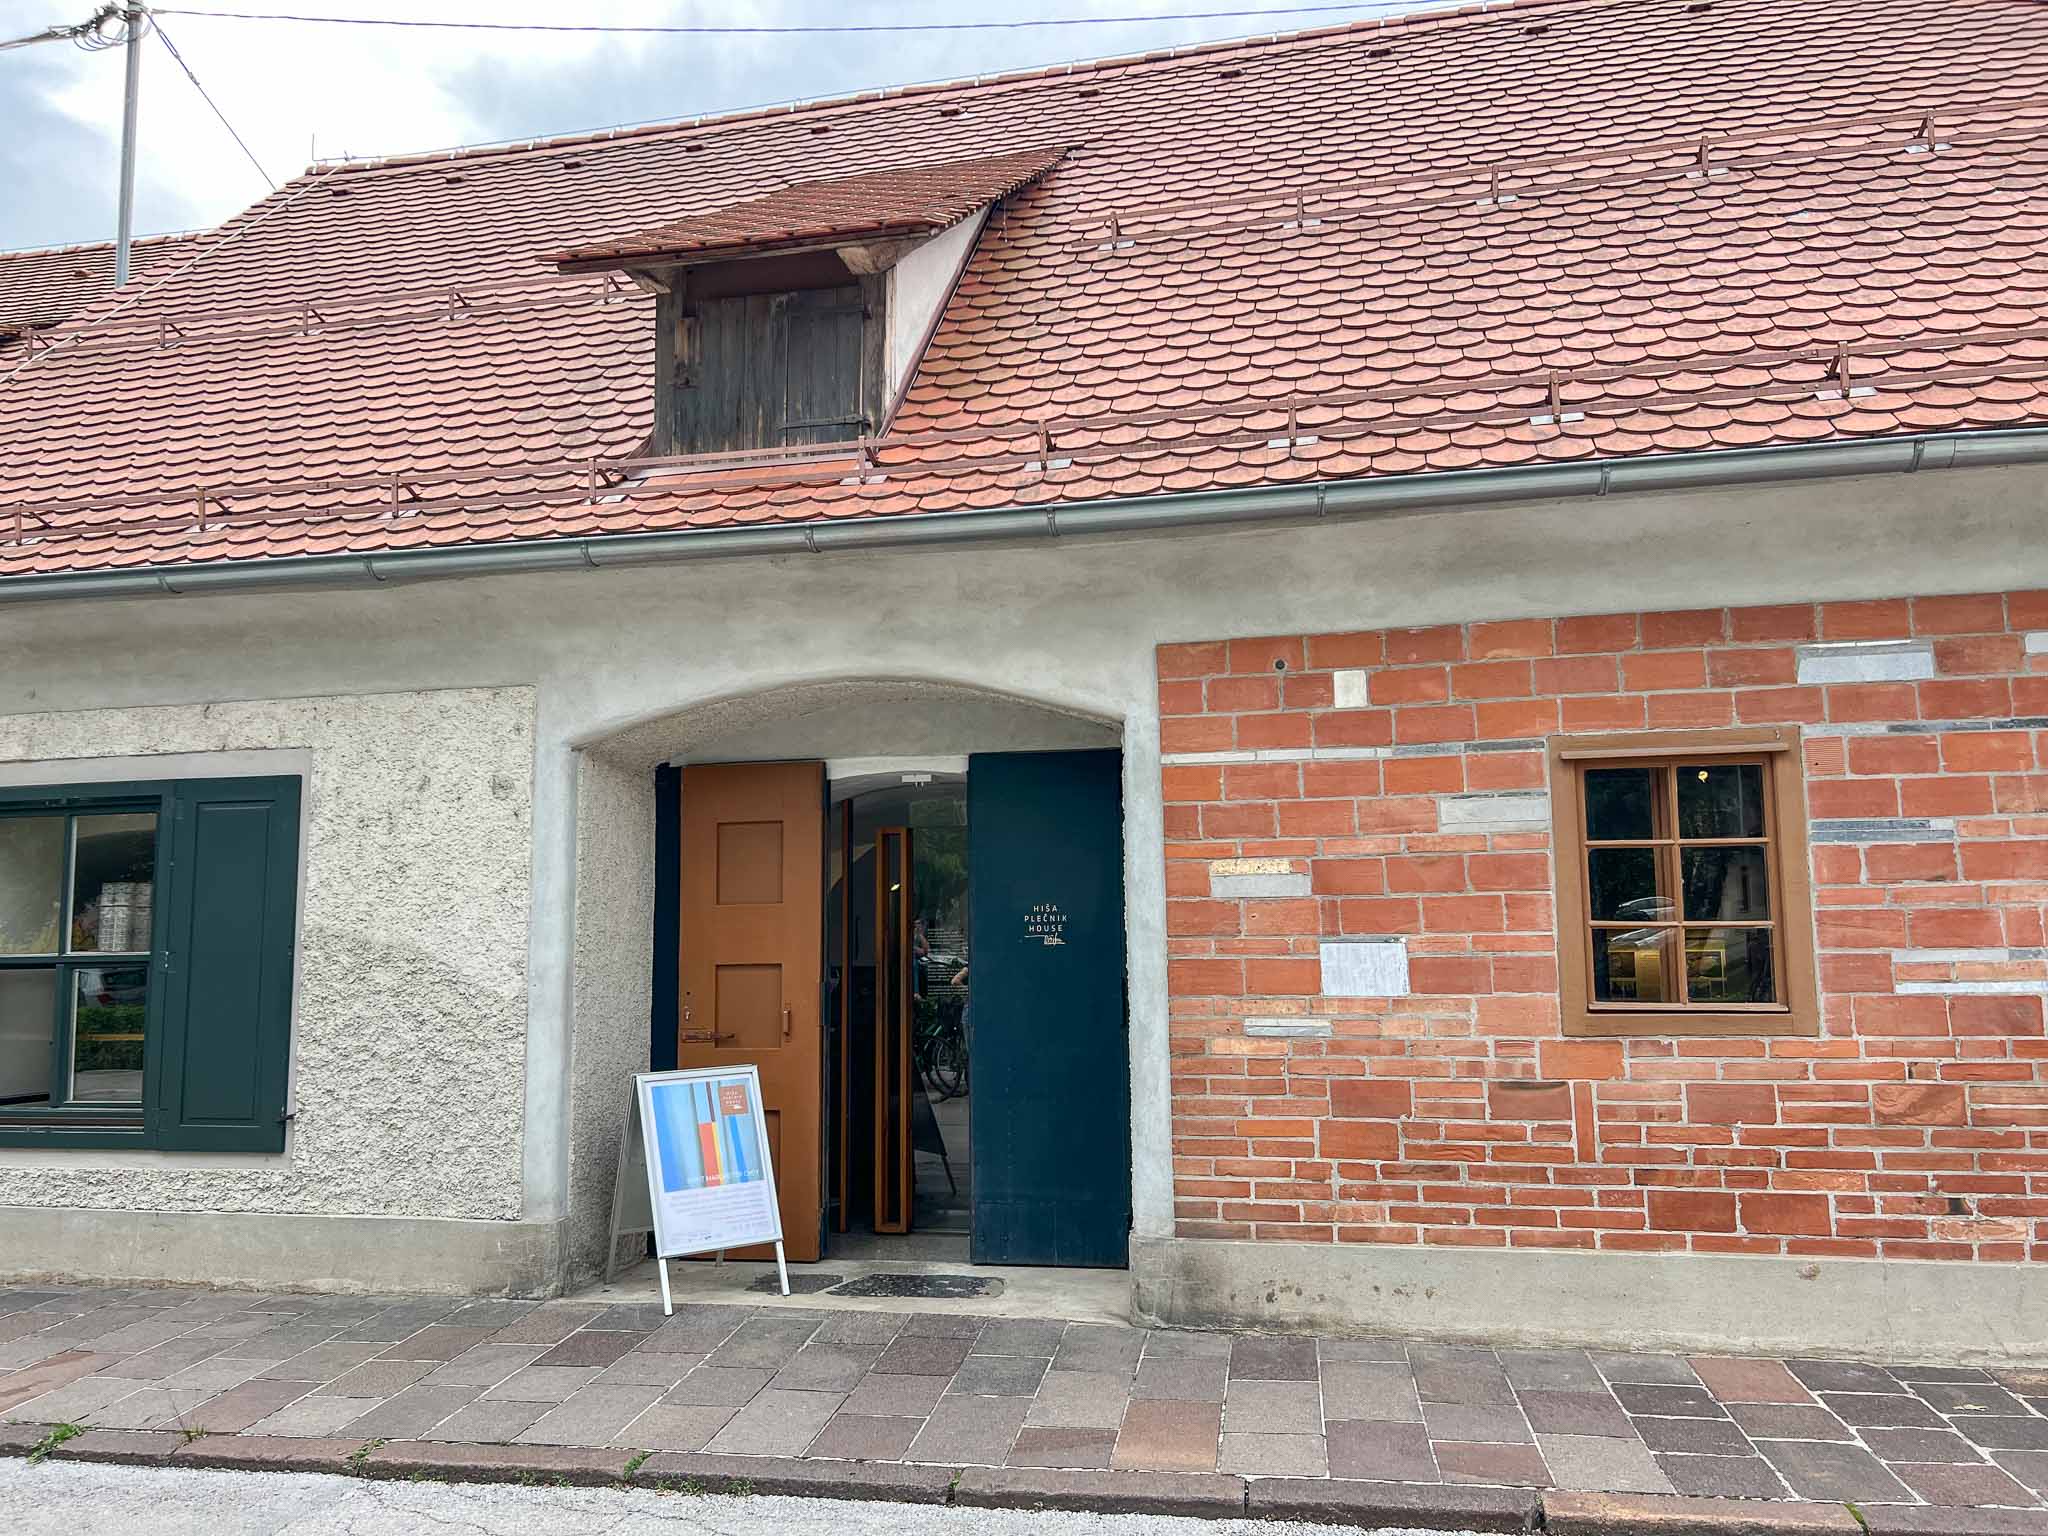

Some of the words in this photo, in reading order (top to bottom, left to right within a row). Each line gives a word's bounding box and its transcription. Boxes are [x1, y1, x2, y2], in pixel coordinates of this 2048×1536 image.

[1033, 903, 1057, 913] HIŠA
[1024, 913, 1068, 922] PLEČNIK
[1029, 924, 1063, 932] HOUSE
